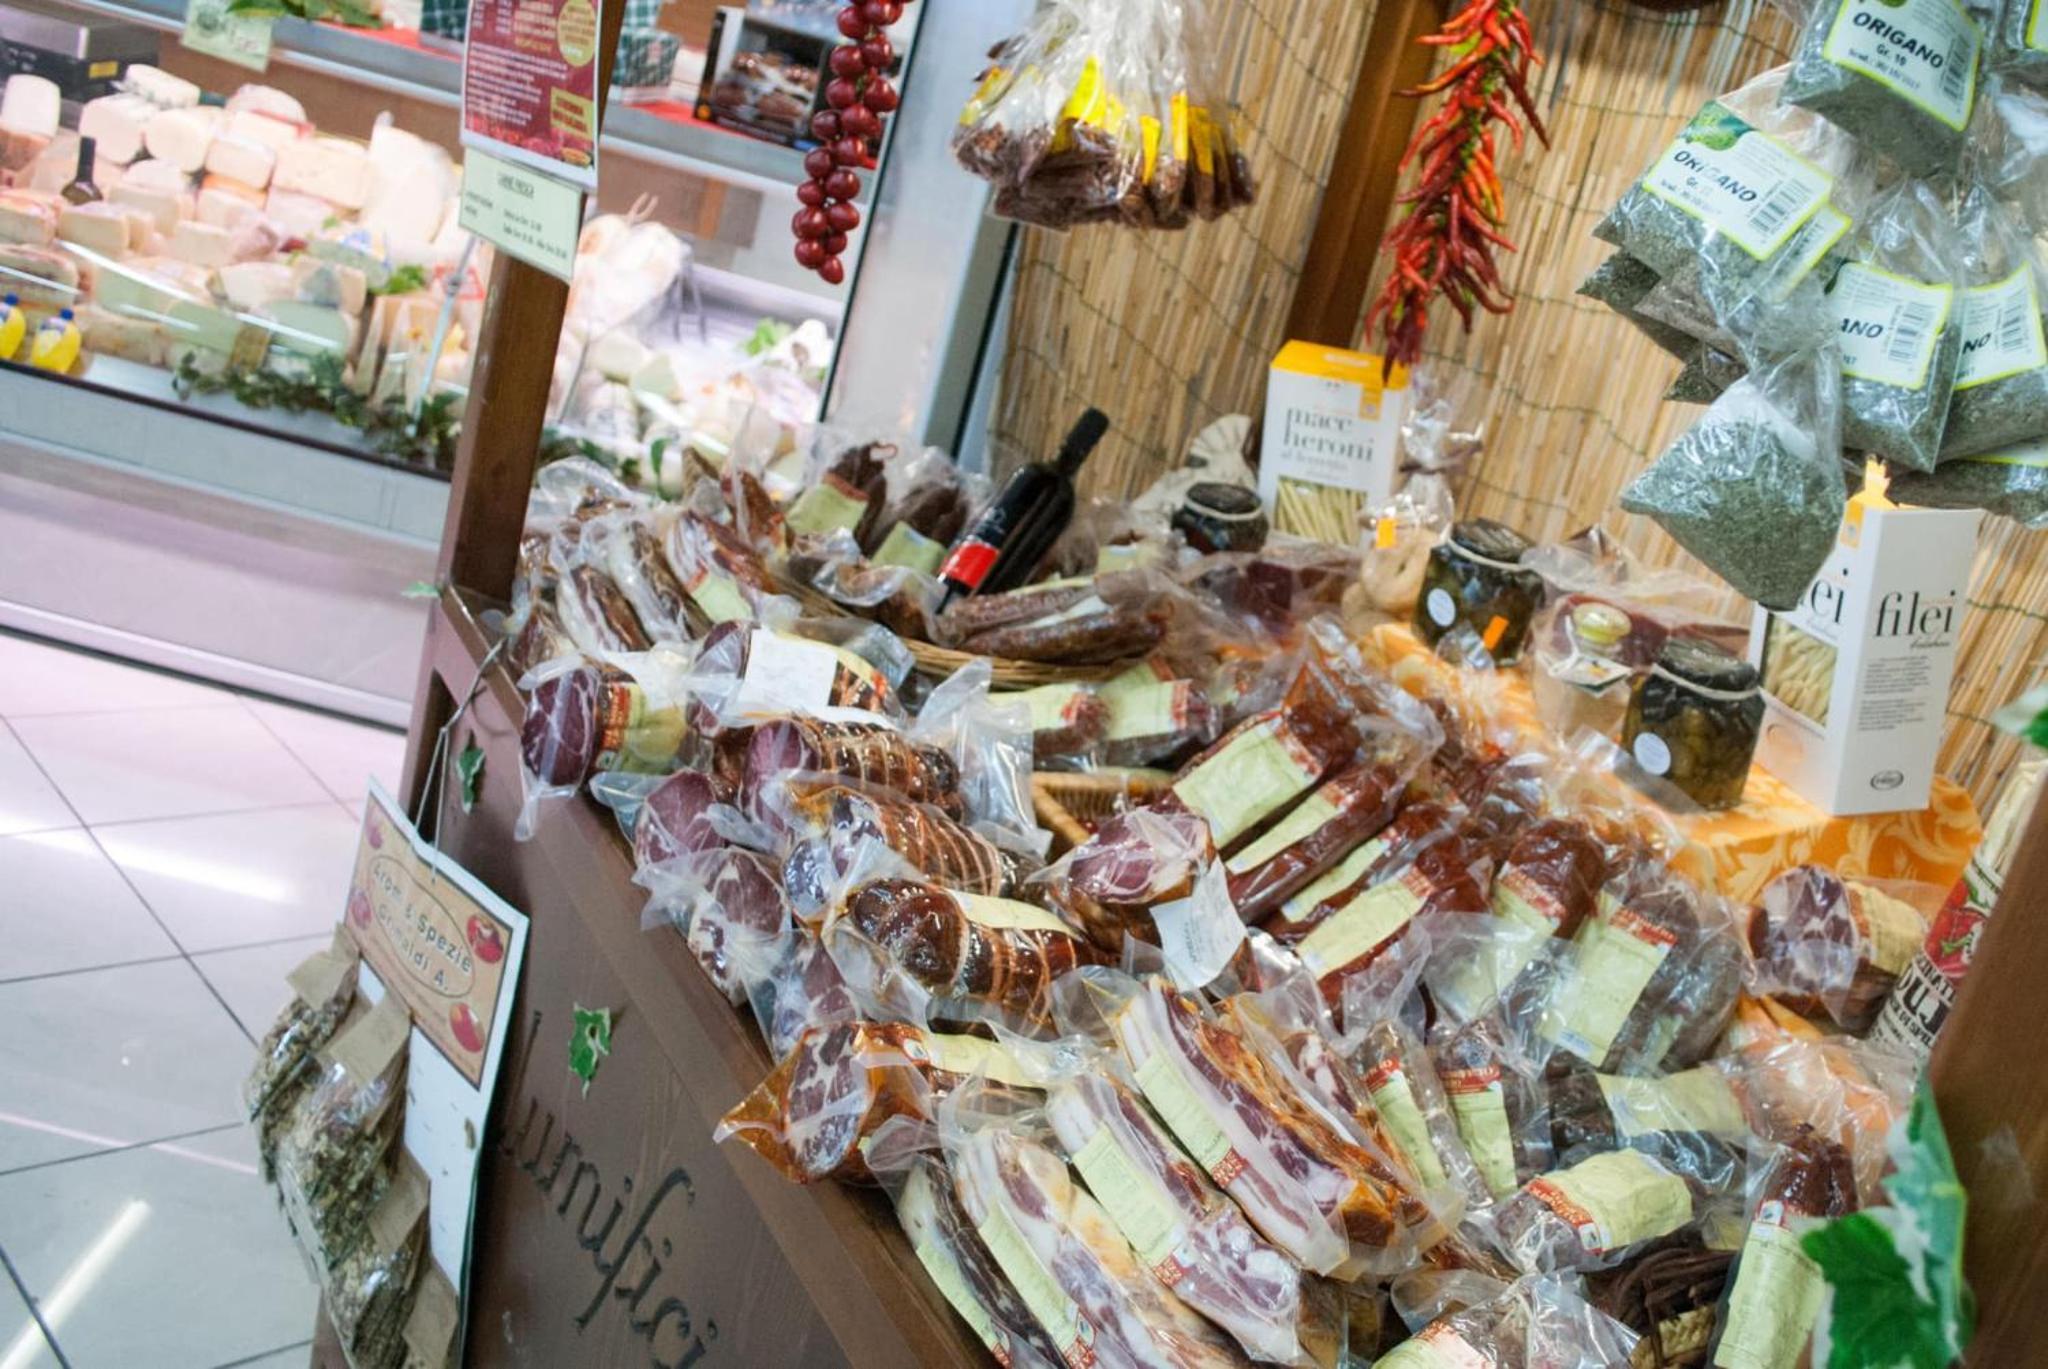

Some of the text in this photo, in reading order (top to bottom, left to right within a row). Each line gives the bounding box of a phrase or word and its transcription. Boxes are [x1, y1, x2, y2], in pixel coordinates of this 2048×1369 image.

[1853, 12, 1944, 69] ORIGANO
[1674, 149, 1757, 202] ORIANO
[1874, 589, 1956, 637] filei
[416, 913, 473, 975] Spezie
